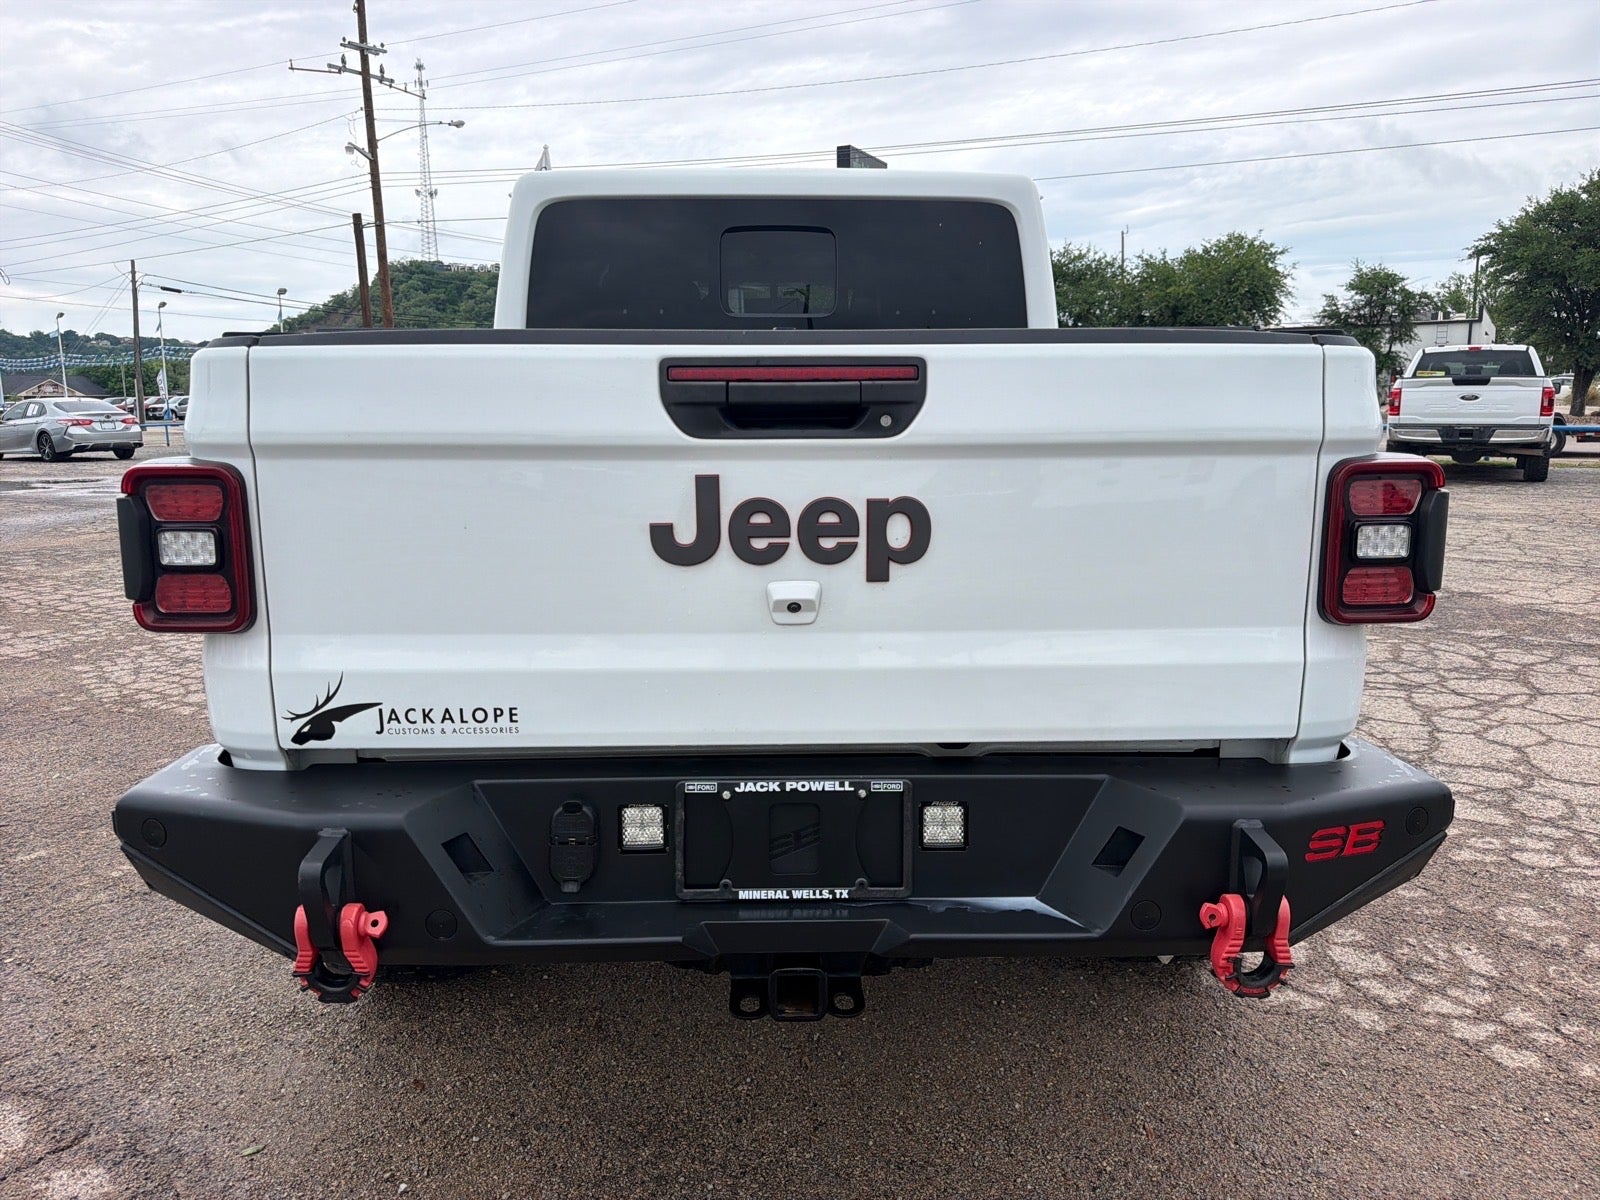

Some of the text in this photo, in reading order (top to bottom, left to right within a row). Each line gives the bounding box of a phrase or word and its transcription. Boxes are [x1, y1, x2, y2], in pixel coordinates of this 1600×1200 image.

[649, 474, 932, 583] Jeep
[376, 707, 519, 735] JACKALOPE
[387, 726, 520, 735] CUSTOMS & ACCESSORIES
[697, 784, 716, 792] FORD
[734, 781, 855, 792] JACK POWELL
[883, 783, 902, 791] FORD
[738, 889, 849, 901] MINERAL WELLS, TX
